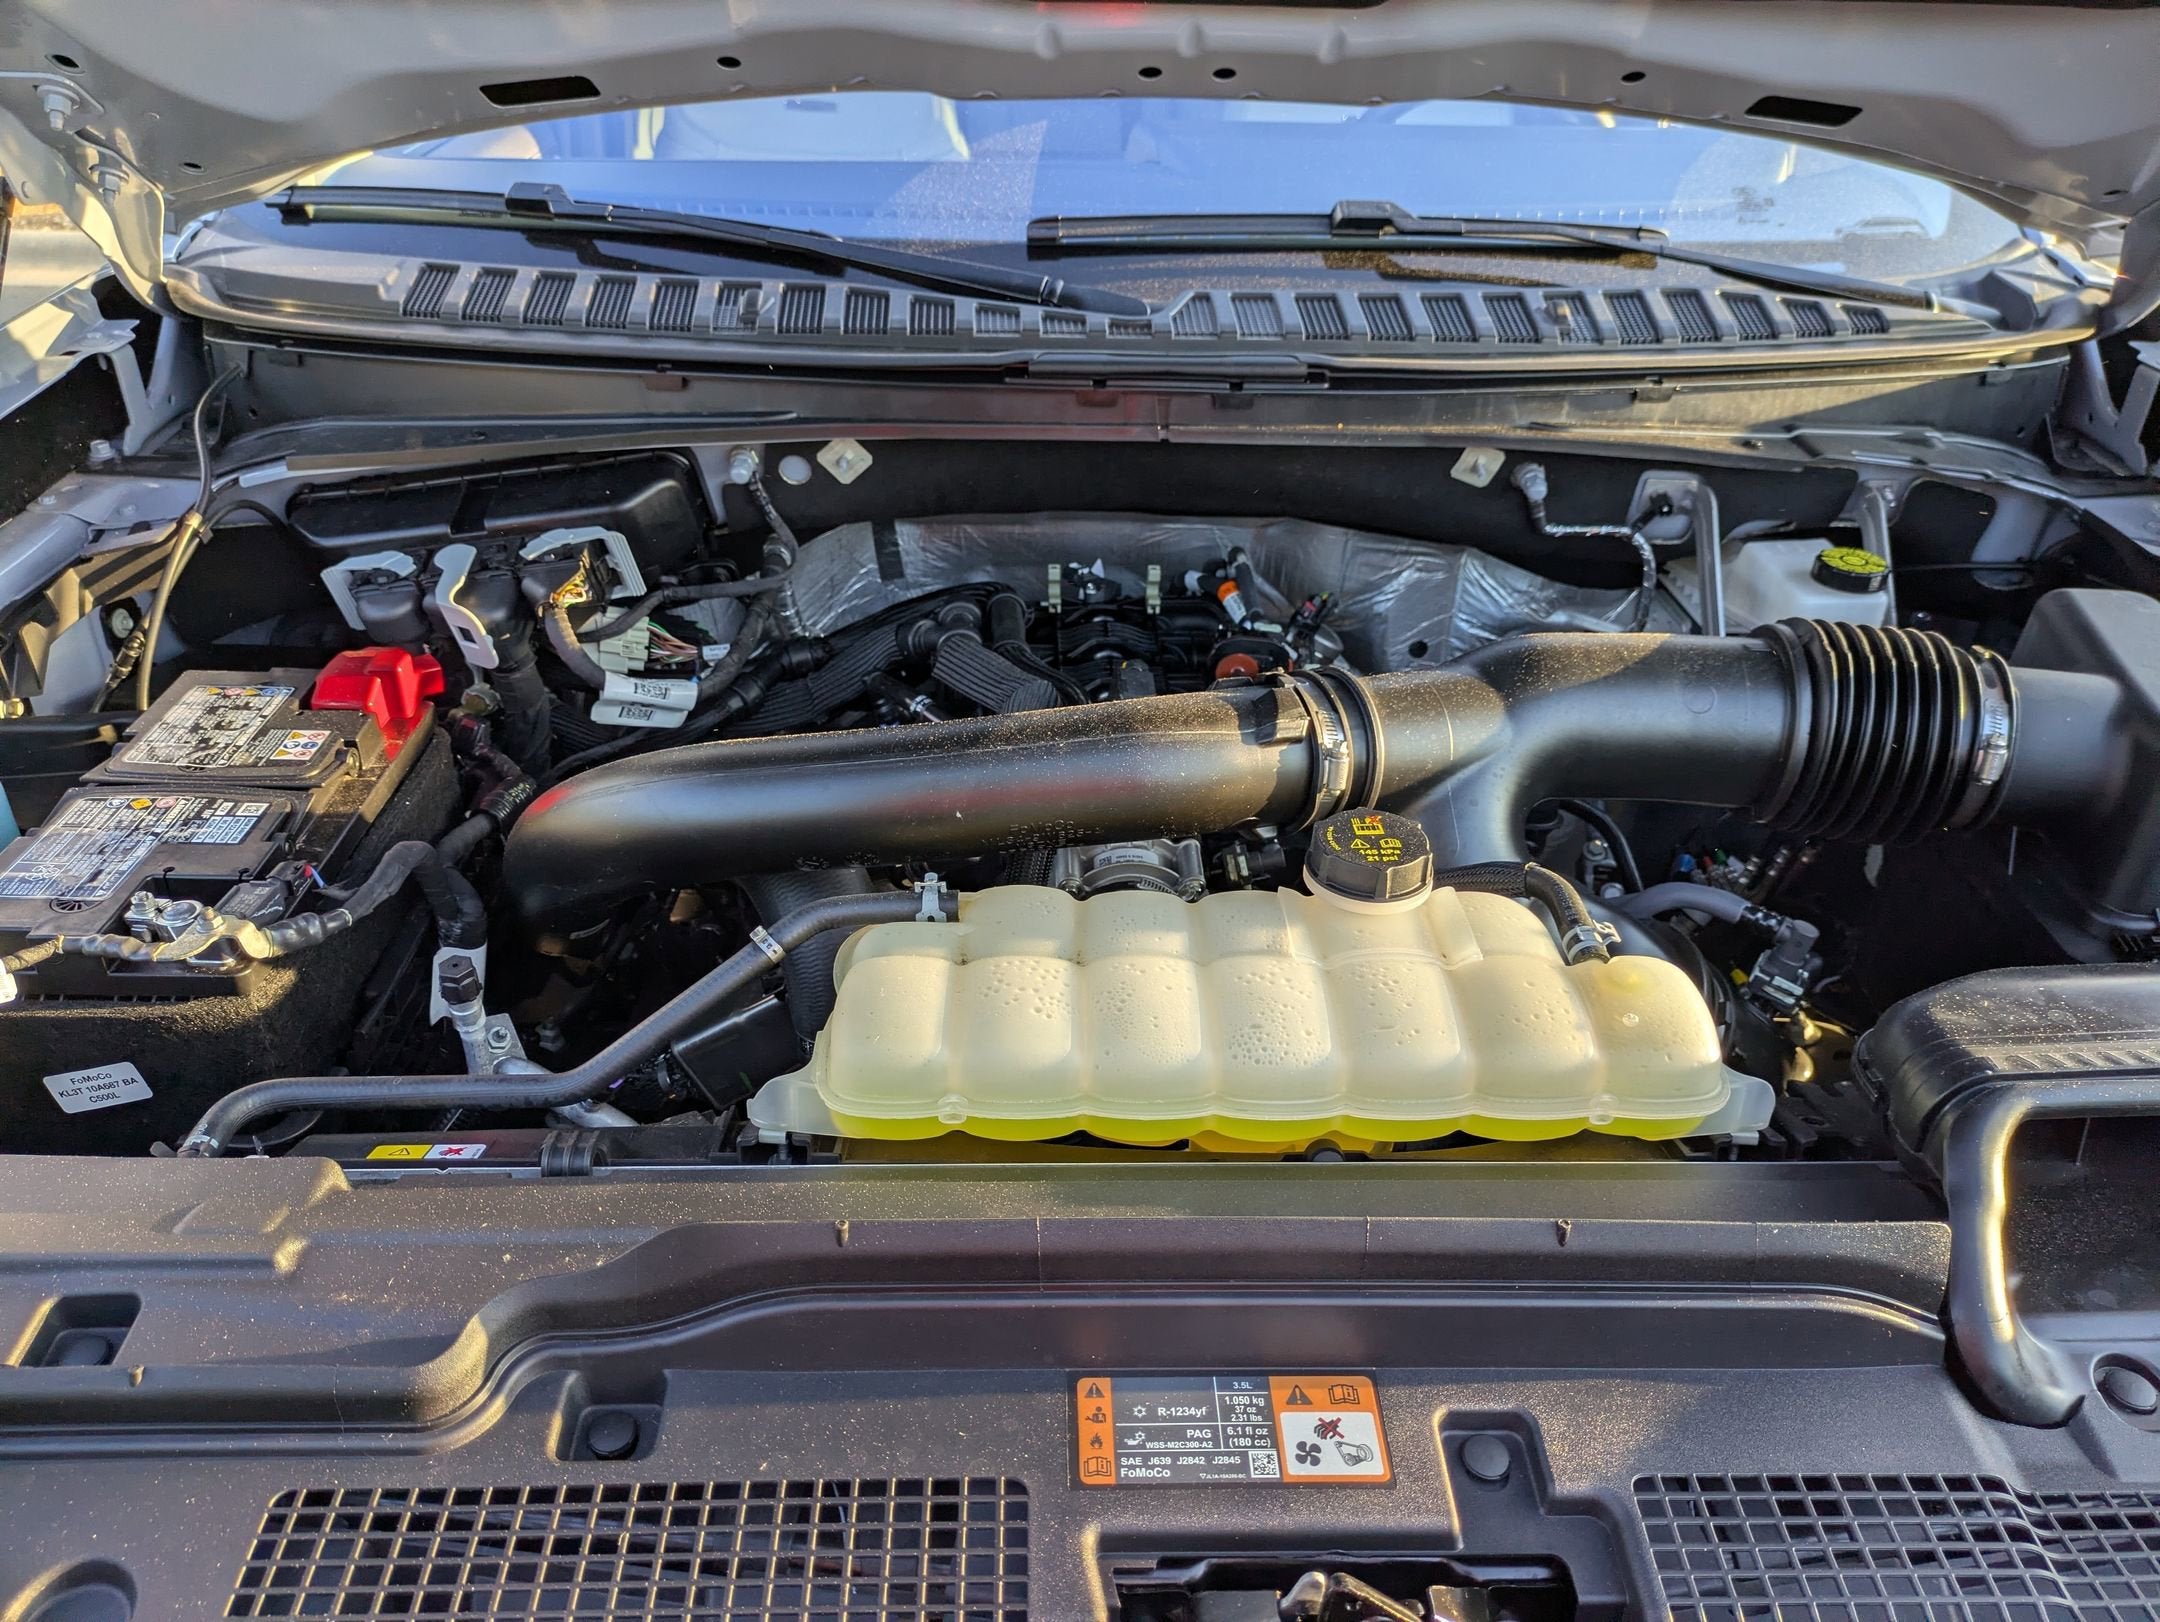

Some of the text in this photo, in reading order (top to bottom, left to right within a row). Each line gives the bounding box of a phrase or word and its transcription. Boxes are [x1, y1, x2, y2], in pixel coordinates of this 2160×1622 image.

[70, 1072, 112, 1085] FoMoCo
[58, 1088, 84, 1098] KL3T
[122, 1077, 139, 1086] BA
[1233, 1381, 1253, 1389] 3.5L
[1224, 1396, 1265, 1407] 1.050 kg
[1158, 1407, 1207, 1418] R-1234yf
[1235, 1405, 1245, 1413] 37
[1230, 1413, 1263, 1421] 2.31 lbs
[1186, 1429, 1212, 1439] PAG
[1226, 1427, 1269, 1437] 6.1 fl oz
[1228, 1437, 1271, 1448] (180 cc)
[1120, 1456, 1241, 1465] SAE J639 J2842 J2845
[1120, 1468, 1171, 1478] FoMoCo
